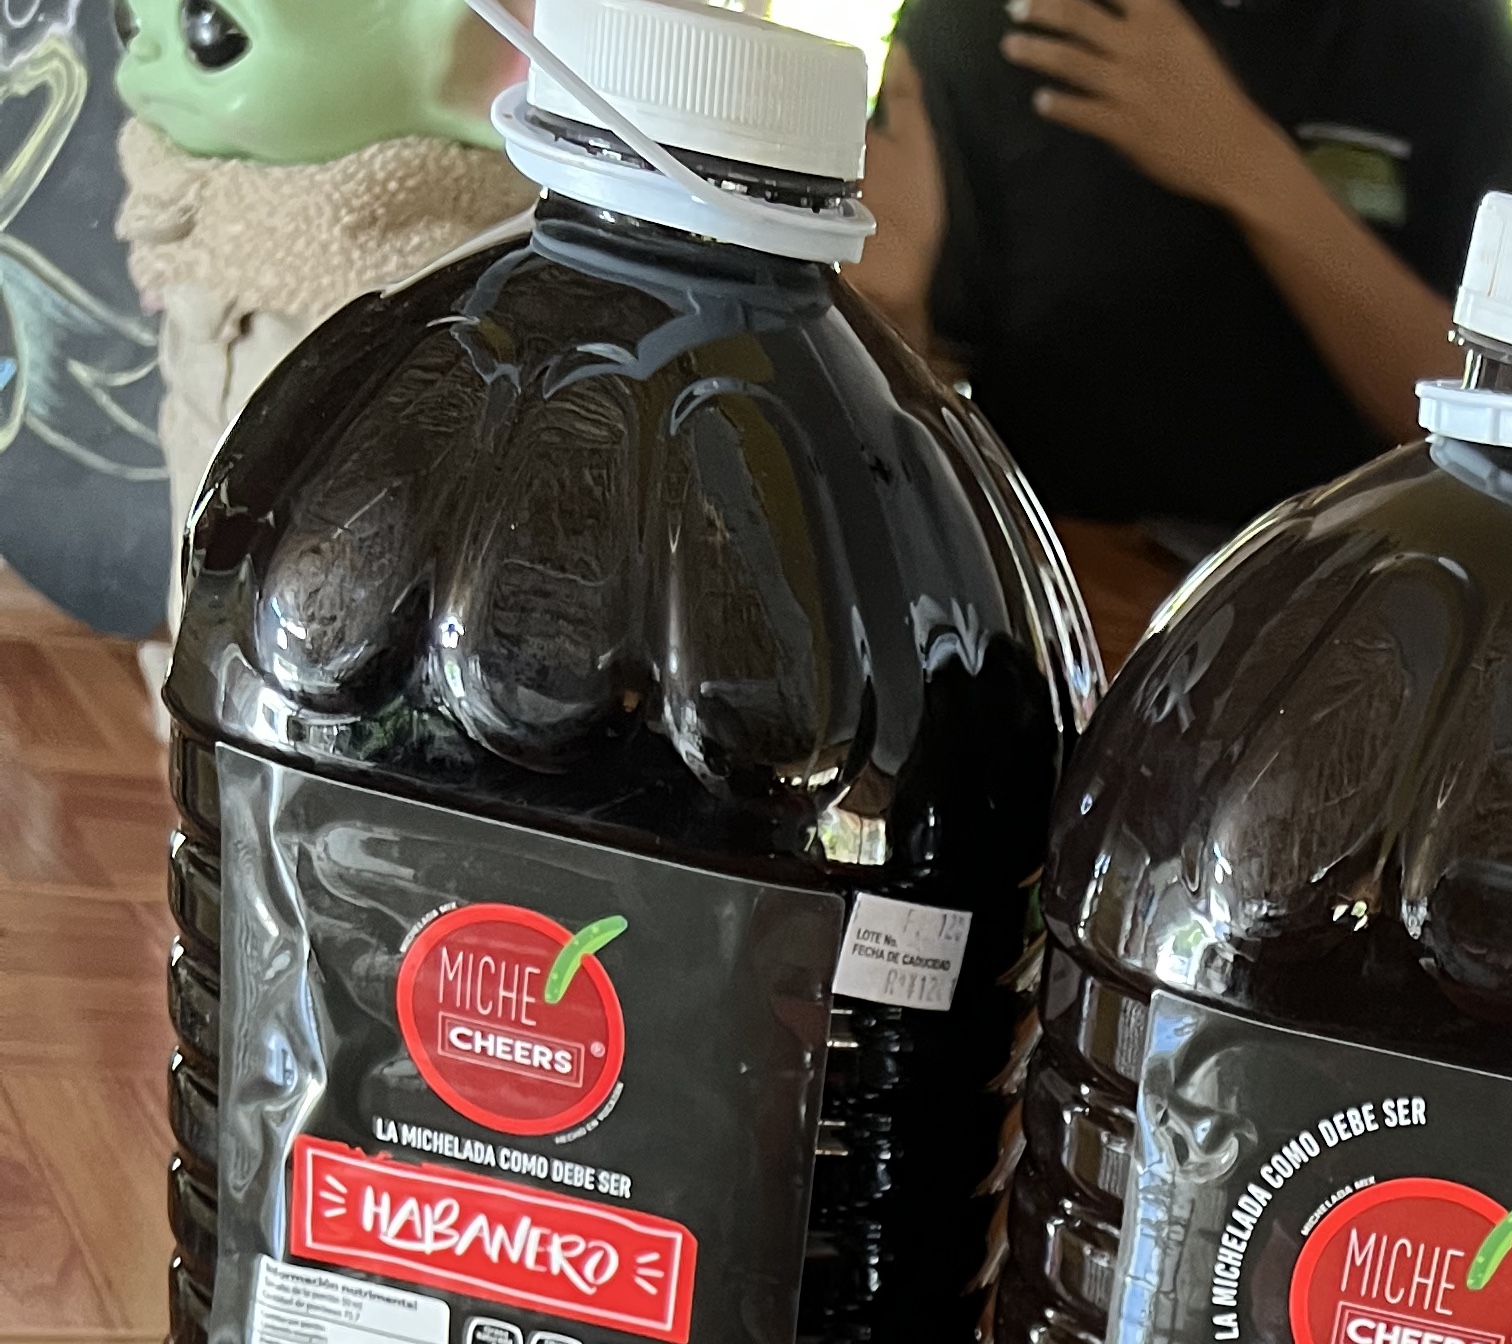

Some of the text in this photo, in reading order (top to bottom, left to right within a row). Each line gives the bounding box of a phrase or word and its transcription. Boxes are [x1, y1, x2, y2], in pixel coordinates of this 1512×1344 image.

[852, 943, 884, 960] FECHA
[886, 950, 900, 964] DE
[856, 928, 881, 944] LOTE
[438, 946, 540, 1026] MICHE
[449, 1026, 573, 1074] CHEERS
[374, 1116, 632, 1199] LA MICHELADA COMO DEBE SER
[362, 1185, 619, 1295] HABANERO
[1212, 1096, 1427, 1341] LA MICHELADA COMO DEBE SER
[1300, 1186, 1353, 1236] MICHELADA
[1340, 1228, 1465, 1315] MICHE
